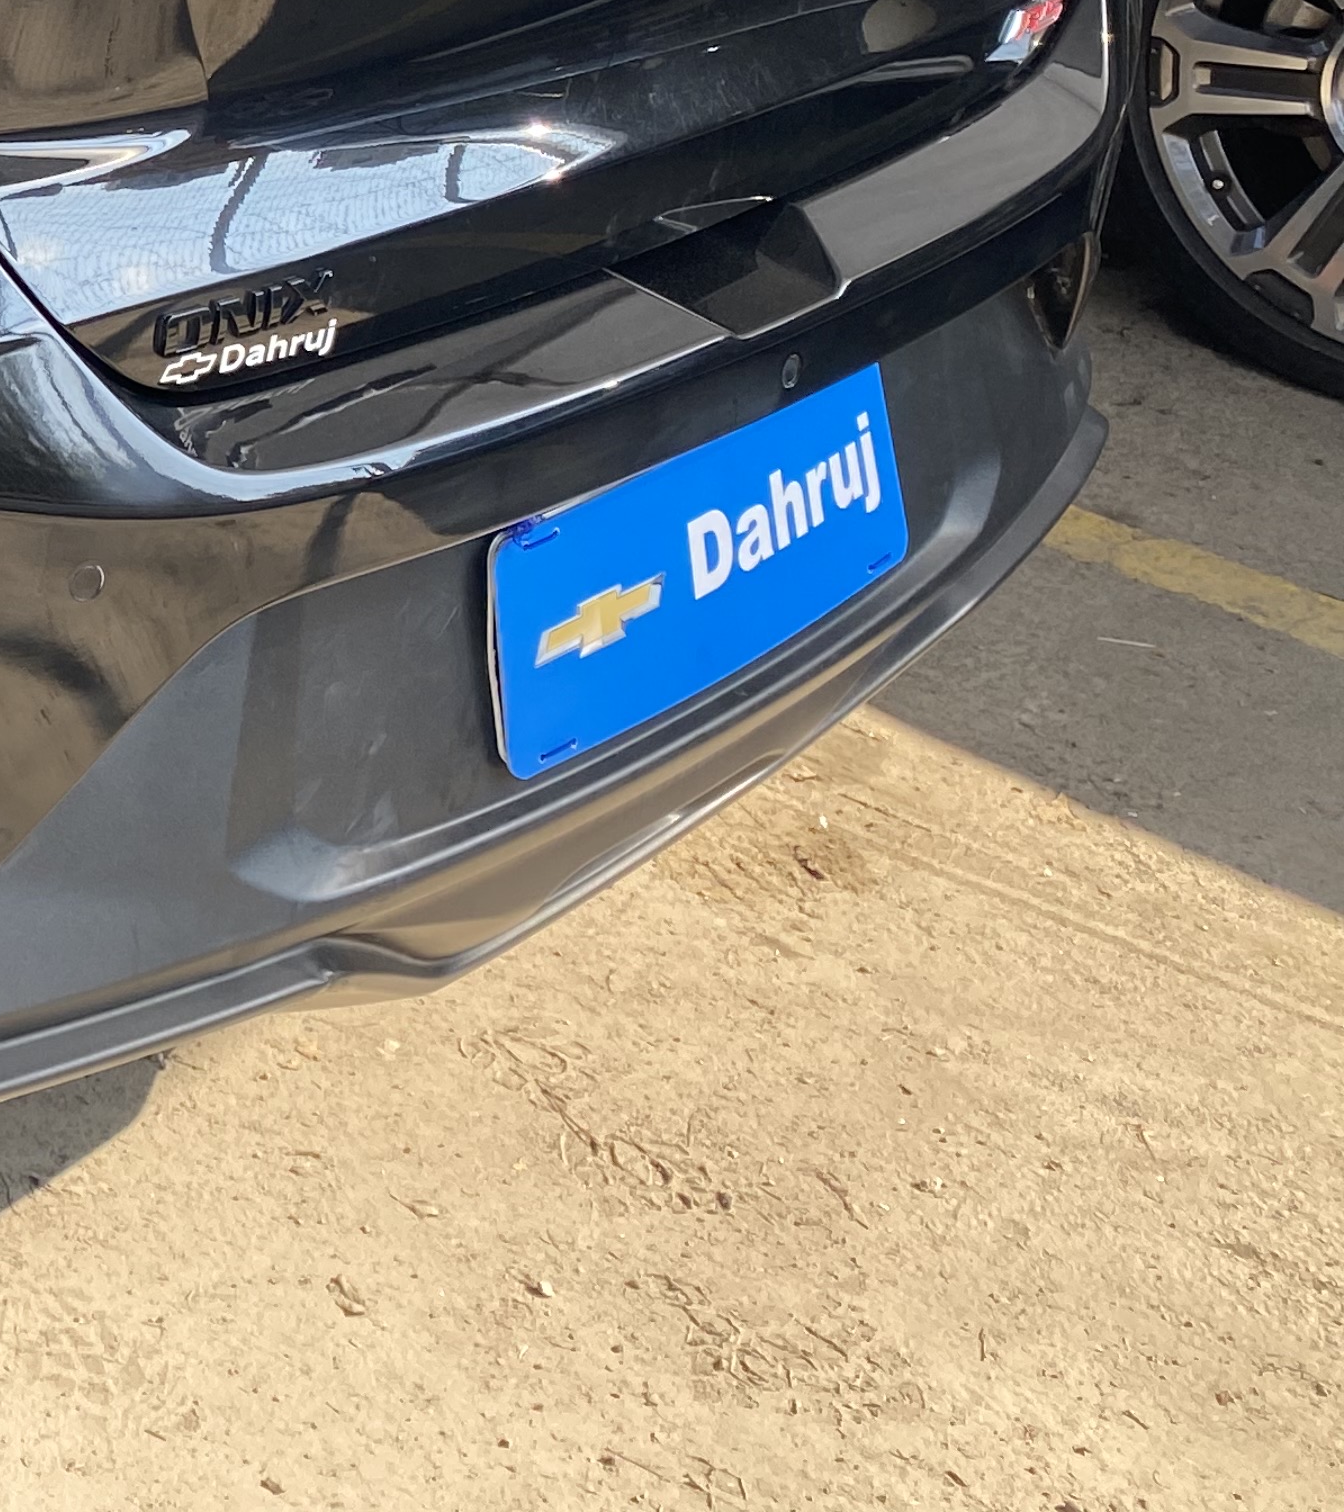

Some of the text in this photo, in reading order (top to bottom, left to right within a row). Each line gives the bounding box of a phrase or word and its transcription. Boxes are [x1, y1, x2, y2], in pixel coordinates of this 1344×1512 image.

[153, 268, 333, 356] ONIX
[218, 318, 337, 374] Dahruj
[686, 410, 882, 601] Dahruj
